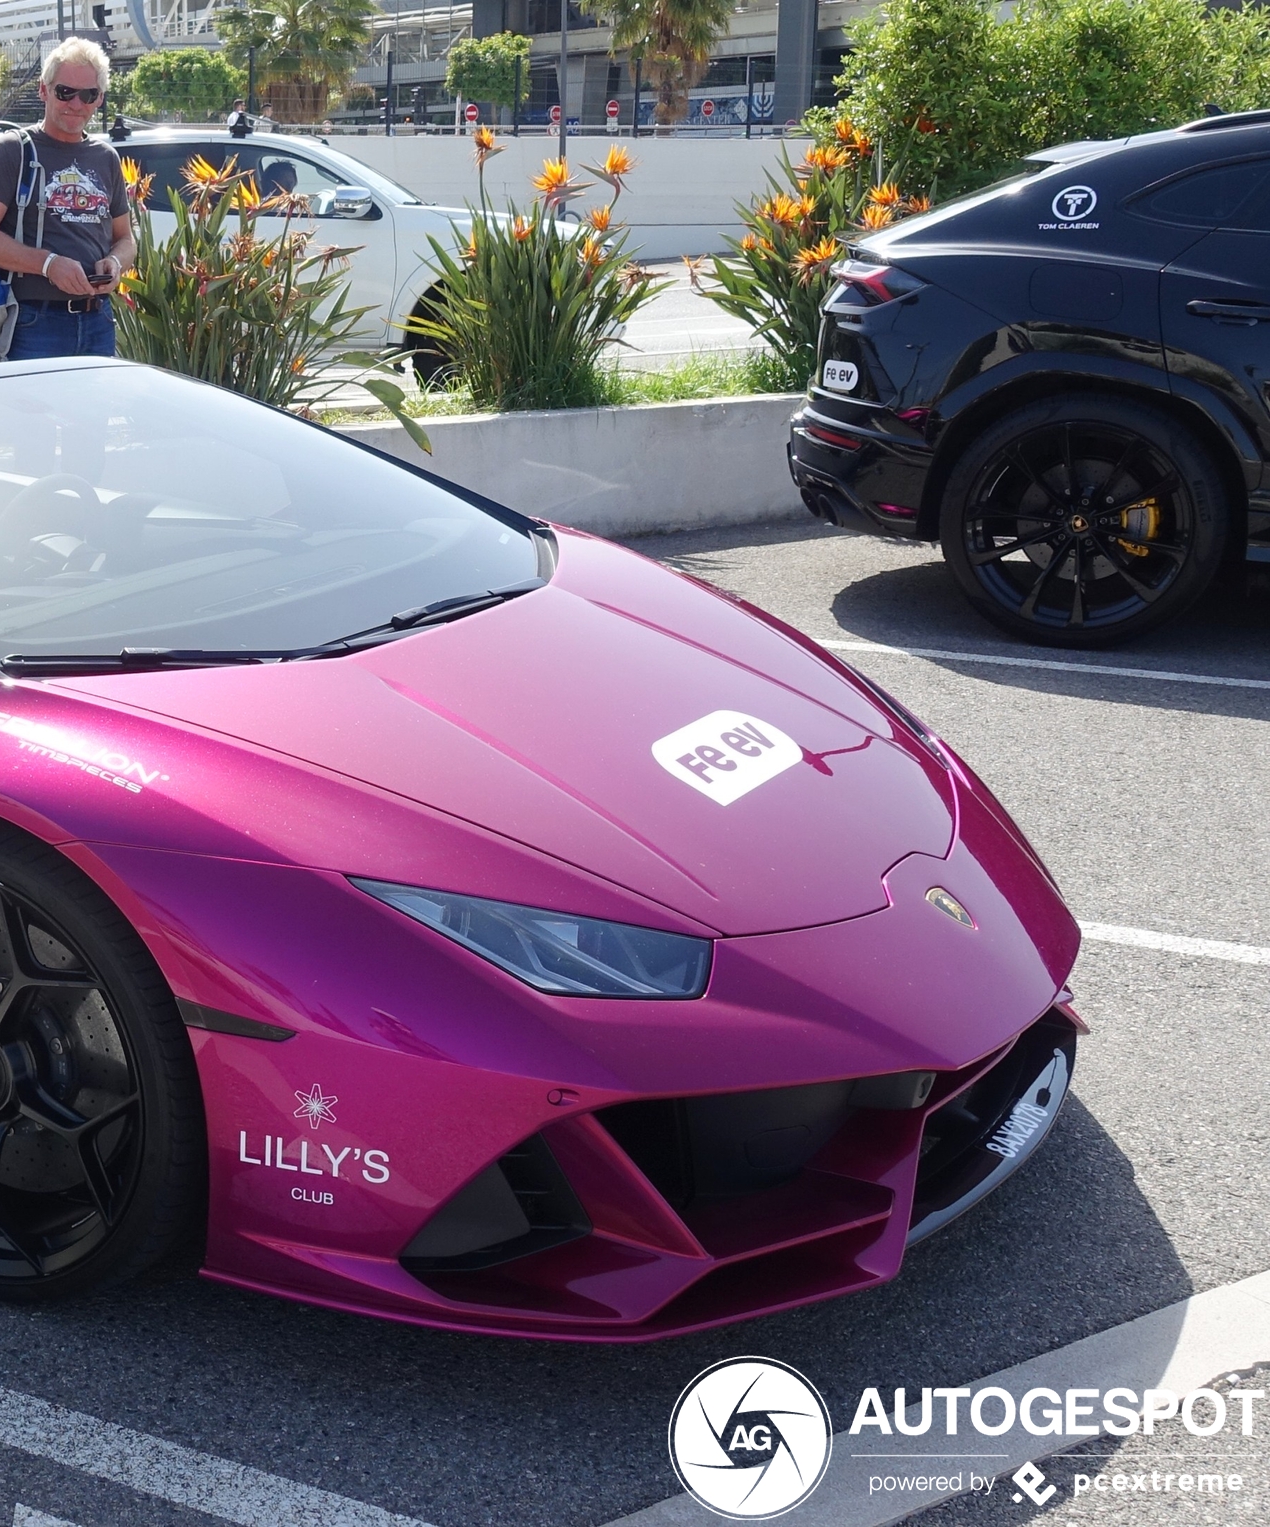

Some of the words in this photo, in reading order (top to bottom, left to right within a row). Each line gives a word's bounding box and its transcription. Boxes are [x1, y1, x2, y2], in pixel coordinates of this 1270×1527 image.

[1057, 222, 1100, 230] CLAEREN
[838, 369, 854, 383] ev
[720, 721, 776, 758] ev
[985, 1102, 1049, 1159] 8AX2078
[239, 1130, 390, 1184] LILLY'S
[290, 1187, 334, 1206] CLUB
